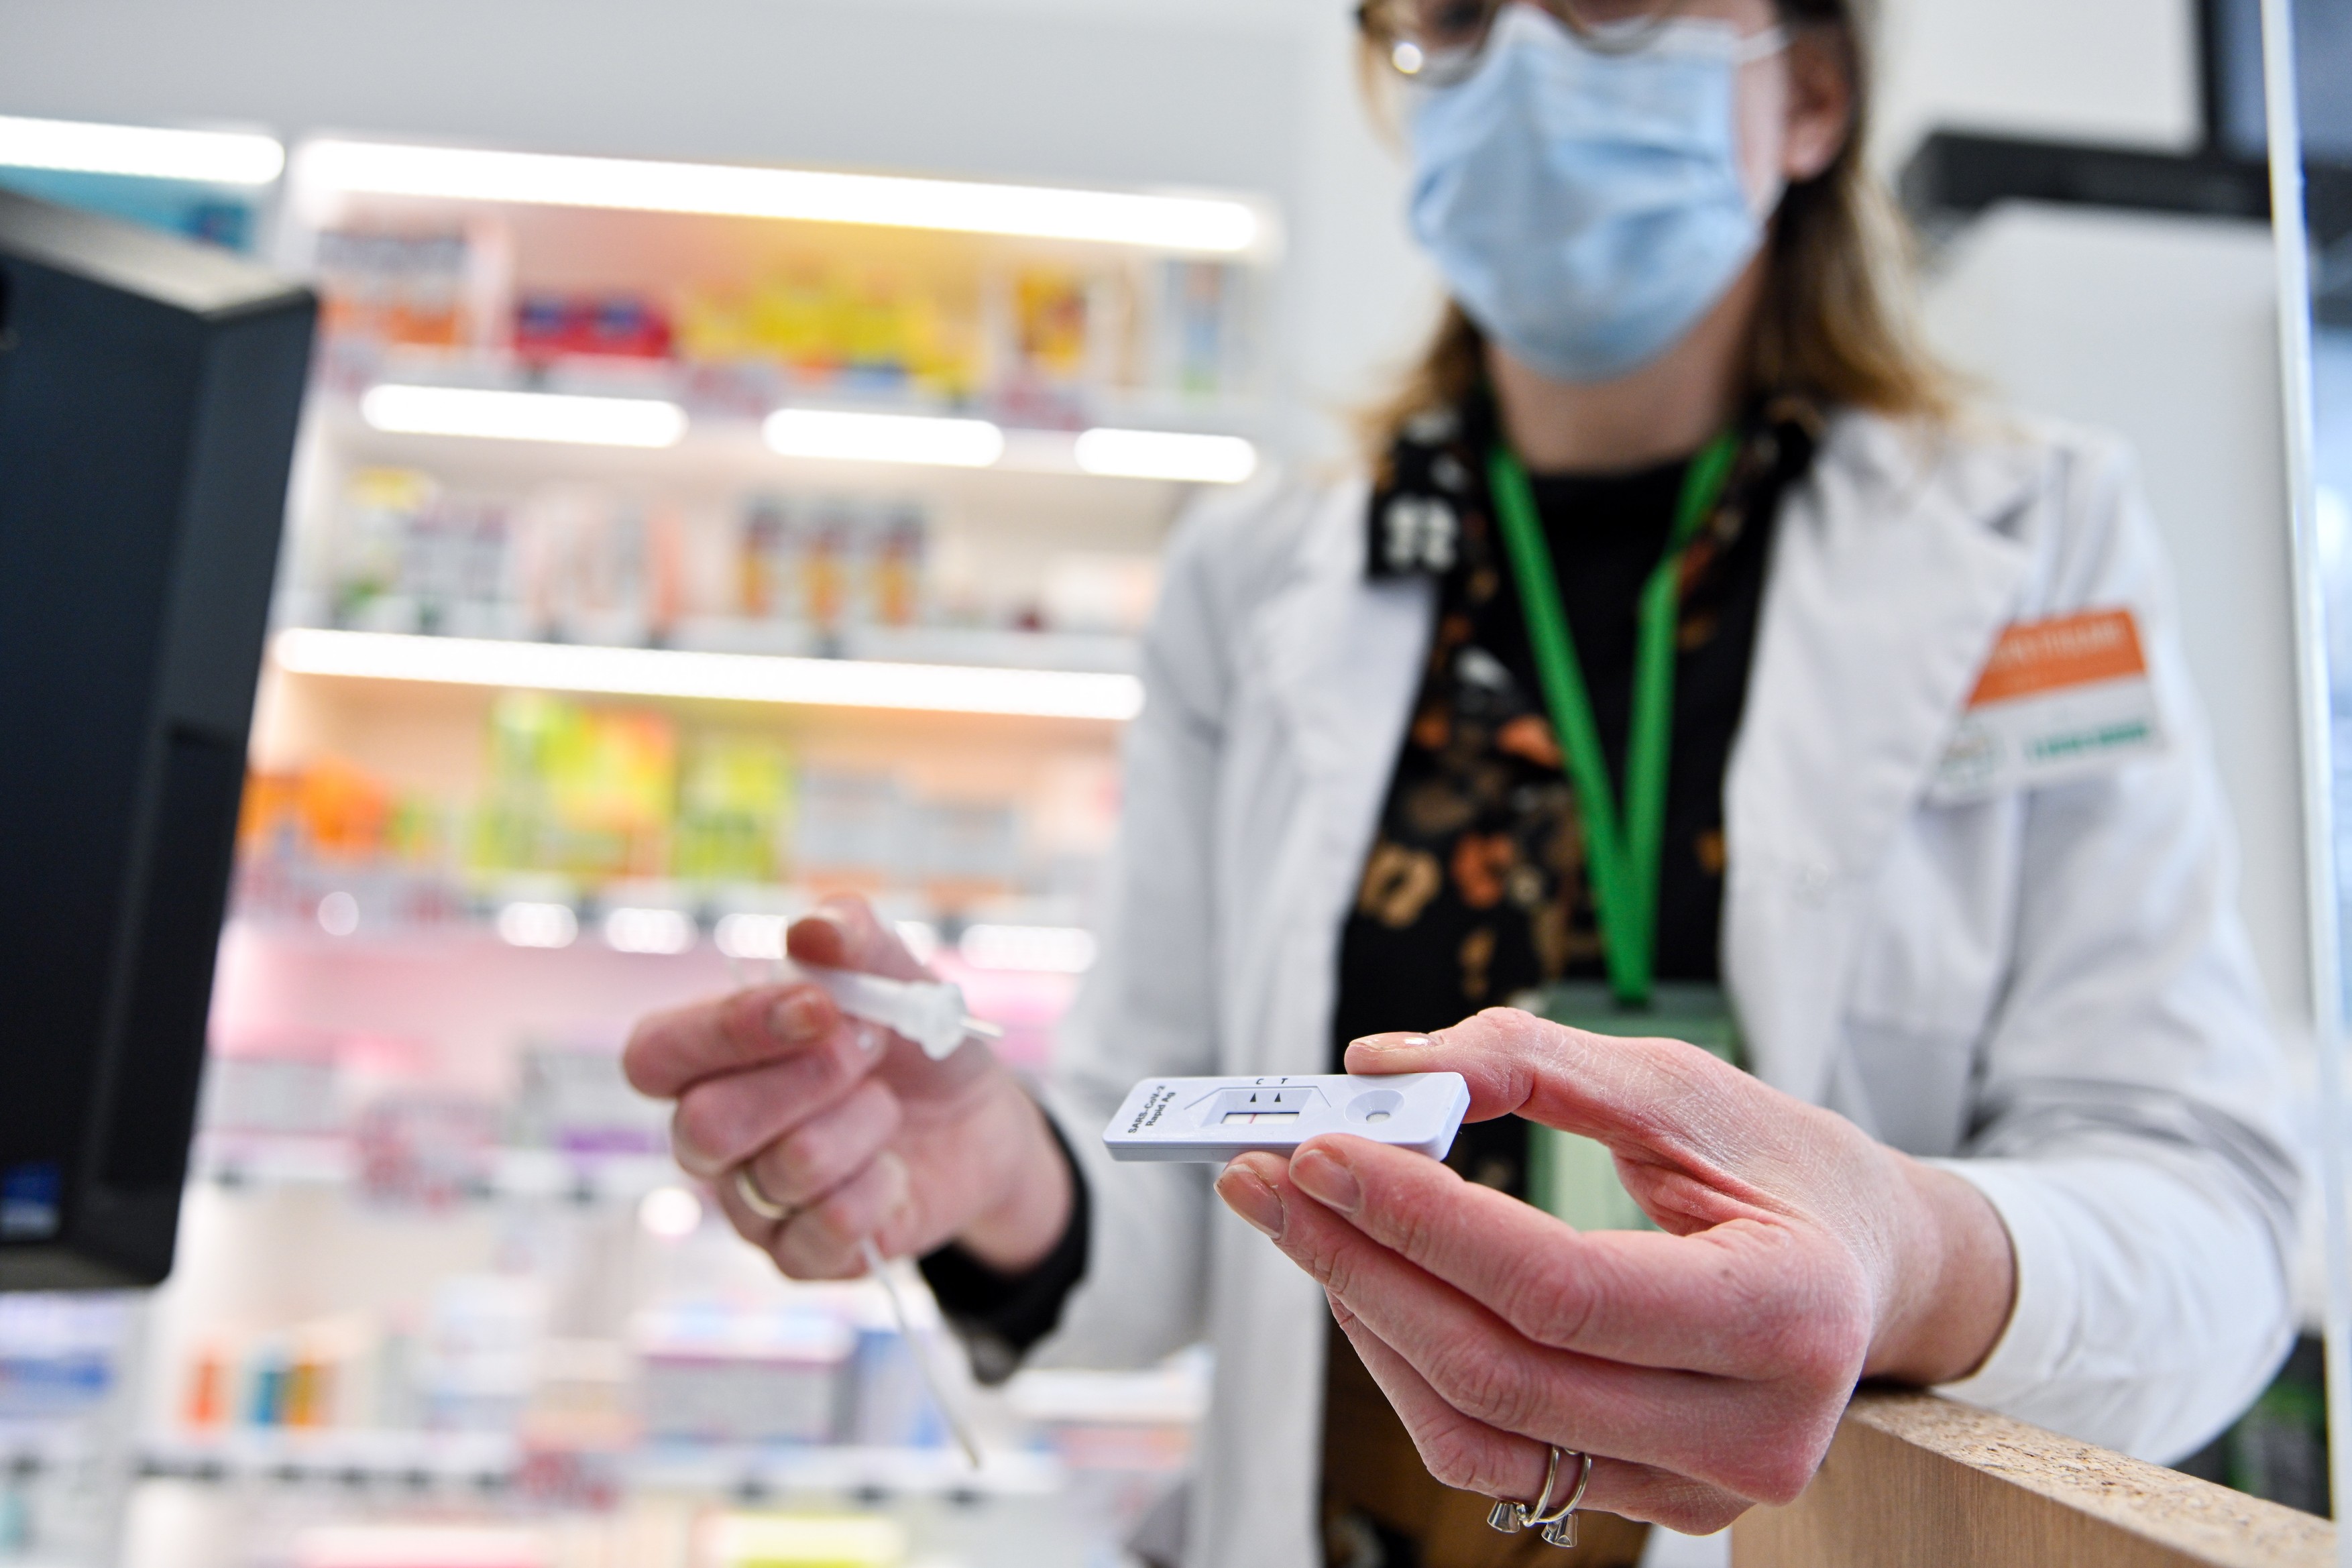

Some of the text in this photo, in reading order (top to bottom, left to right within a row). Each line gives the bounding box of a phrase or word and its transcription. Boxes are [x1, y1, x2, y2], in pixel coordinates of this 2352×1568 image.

[1127, 1085, 1166, 1133] SARS-CoV-2
[1145, 1092, 1176, 1126] Rapid Ag
